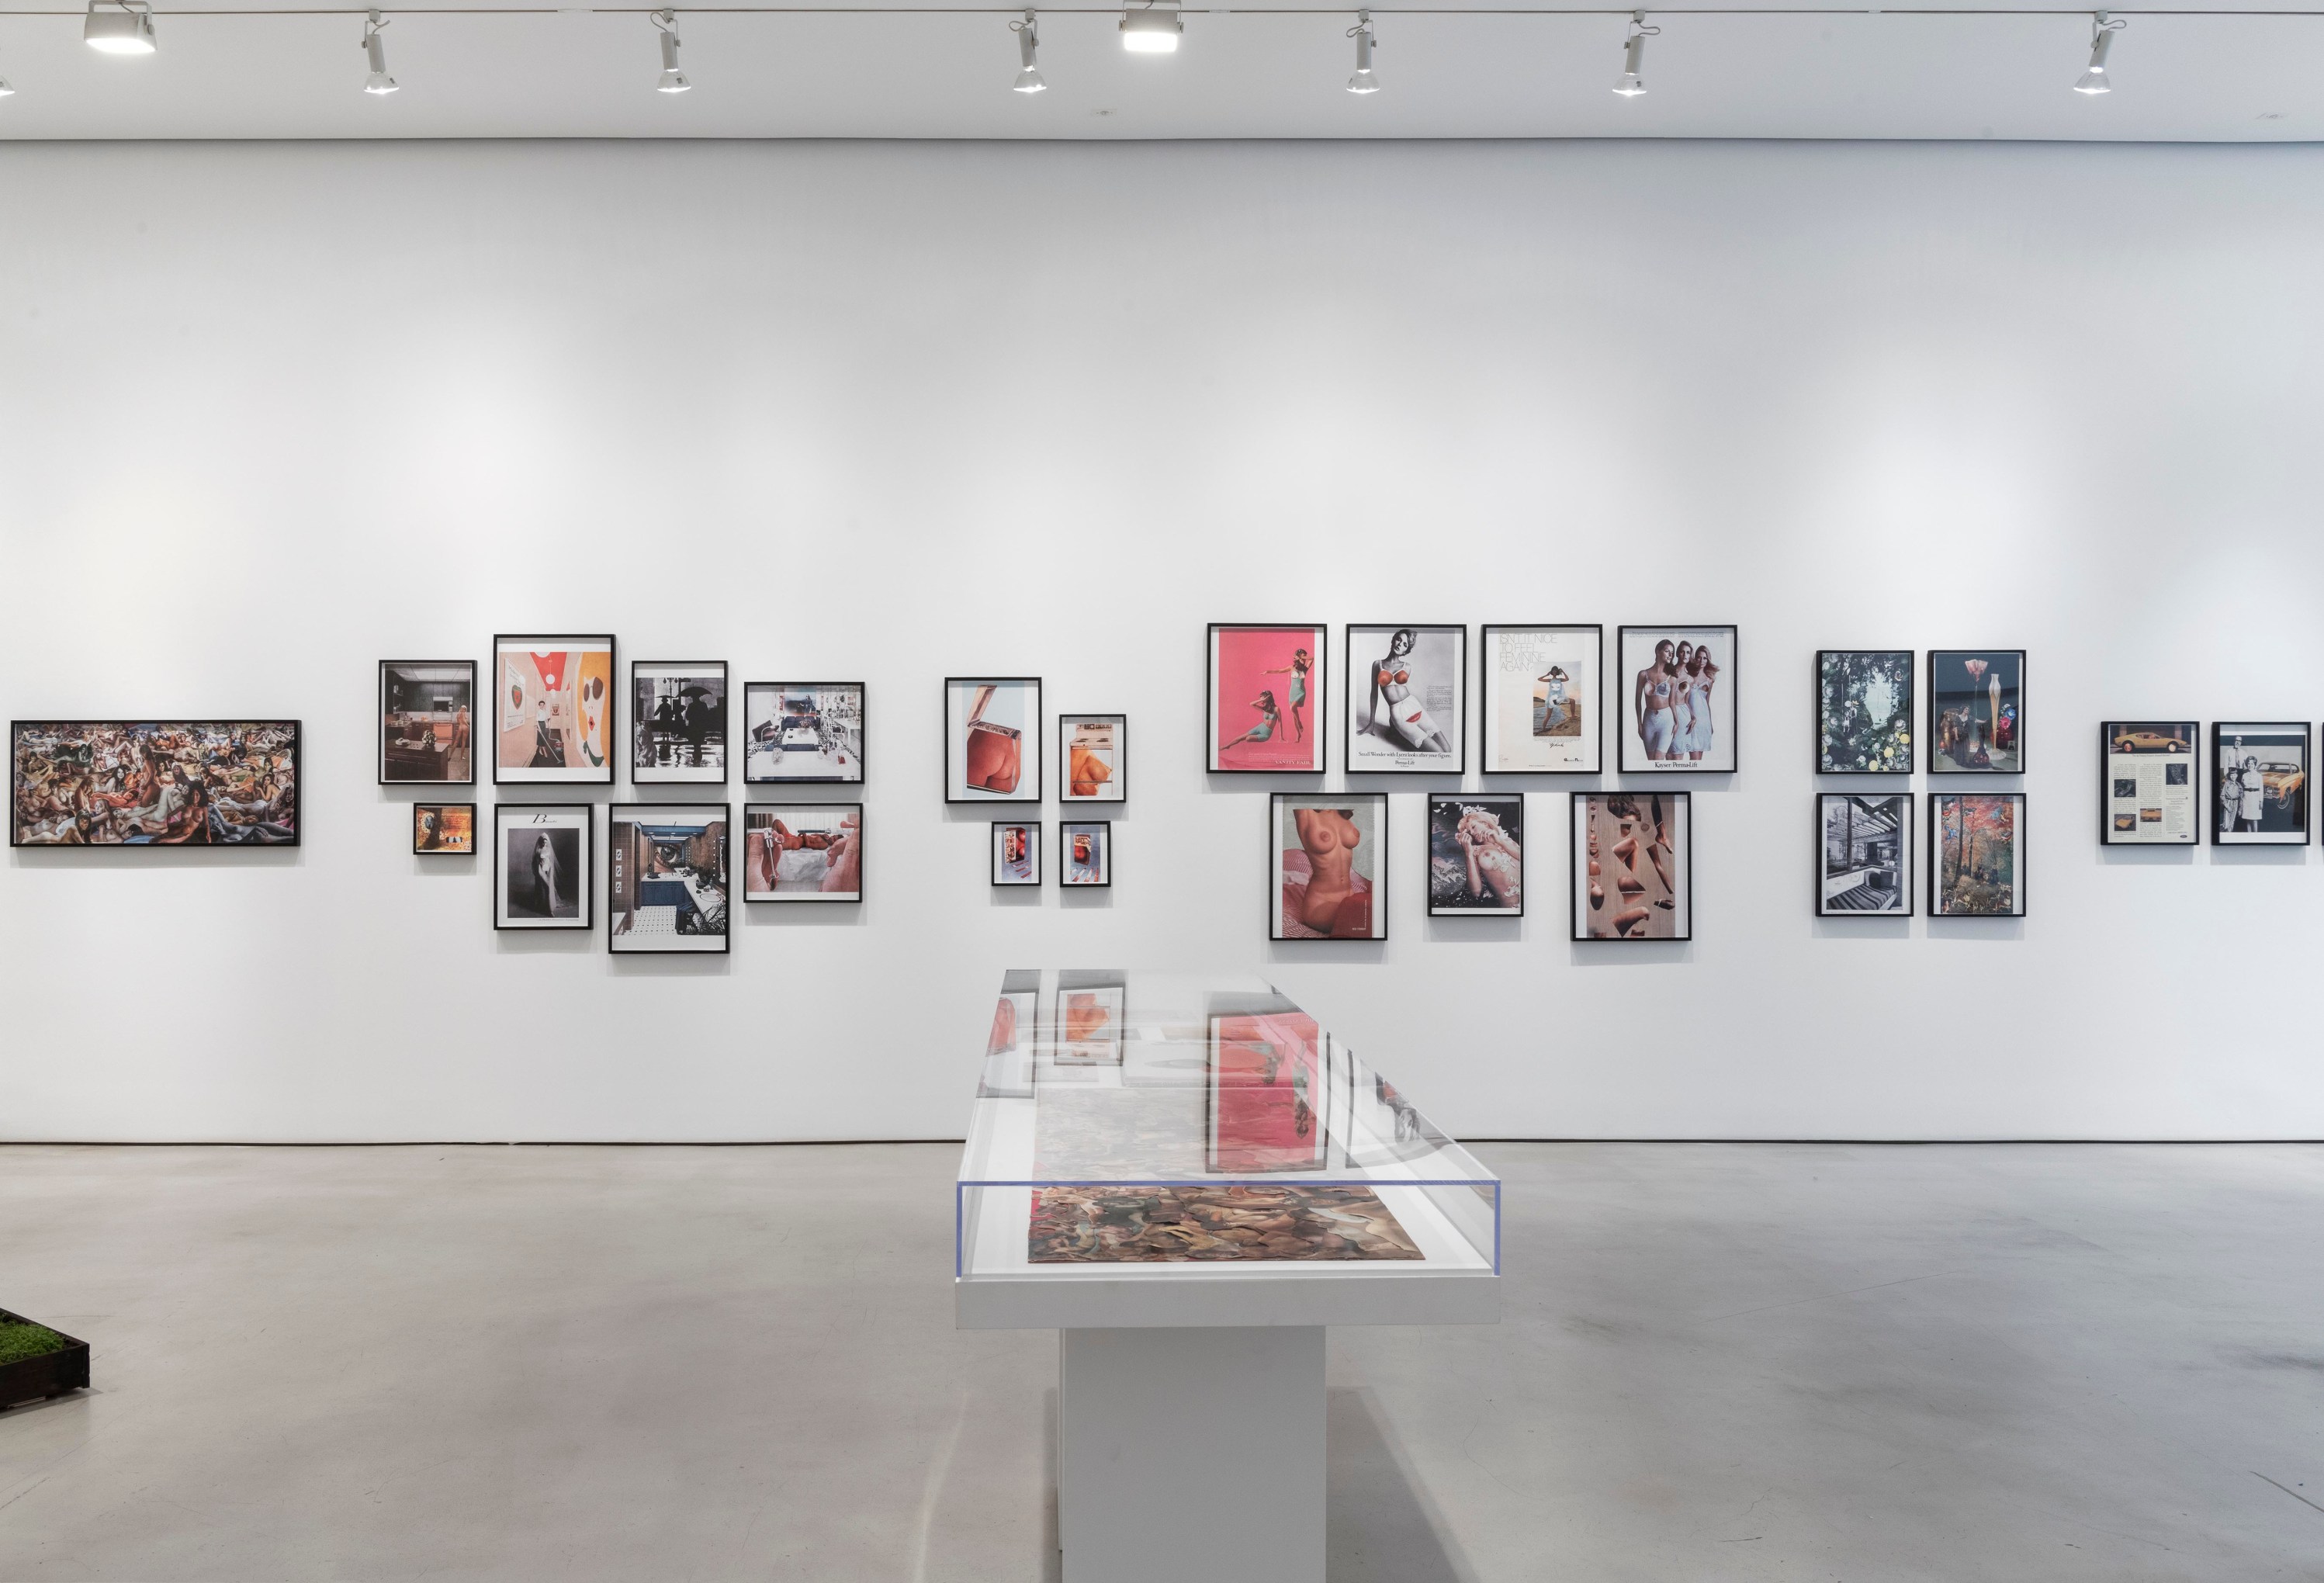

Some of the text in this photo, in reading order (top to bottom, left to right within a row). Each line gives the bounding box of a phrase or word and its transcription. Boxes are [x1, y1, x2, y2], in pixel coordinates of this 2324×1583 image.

[1534, 633, 1558, 644] NICE
[1499, 643, 1538, 653] TO FEEL
[1499, 653, 1546, 662] FEMININE
